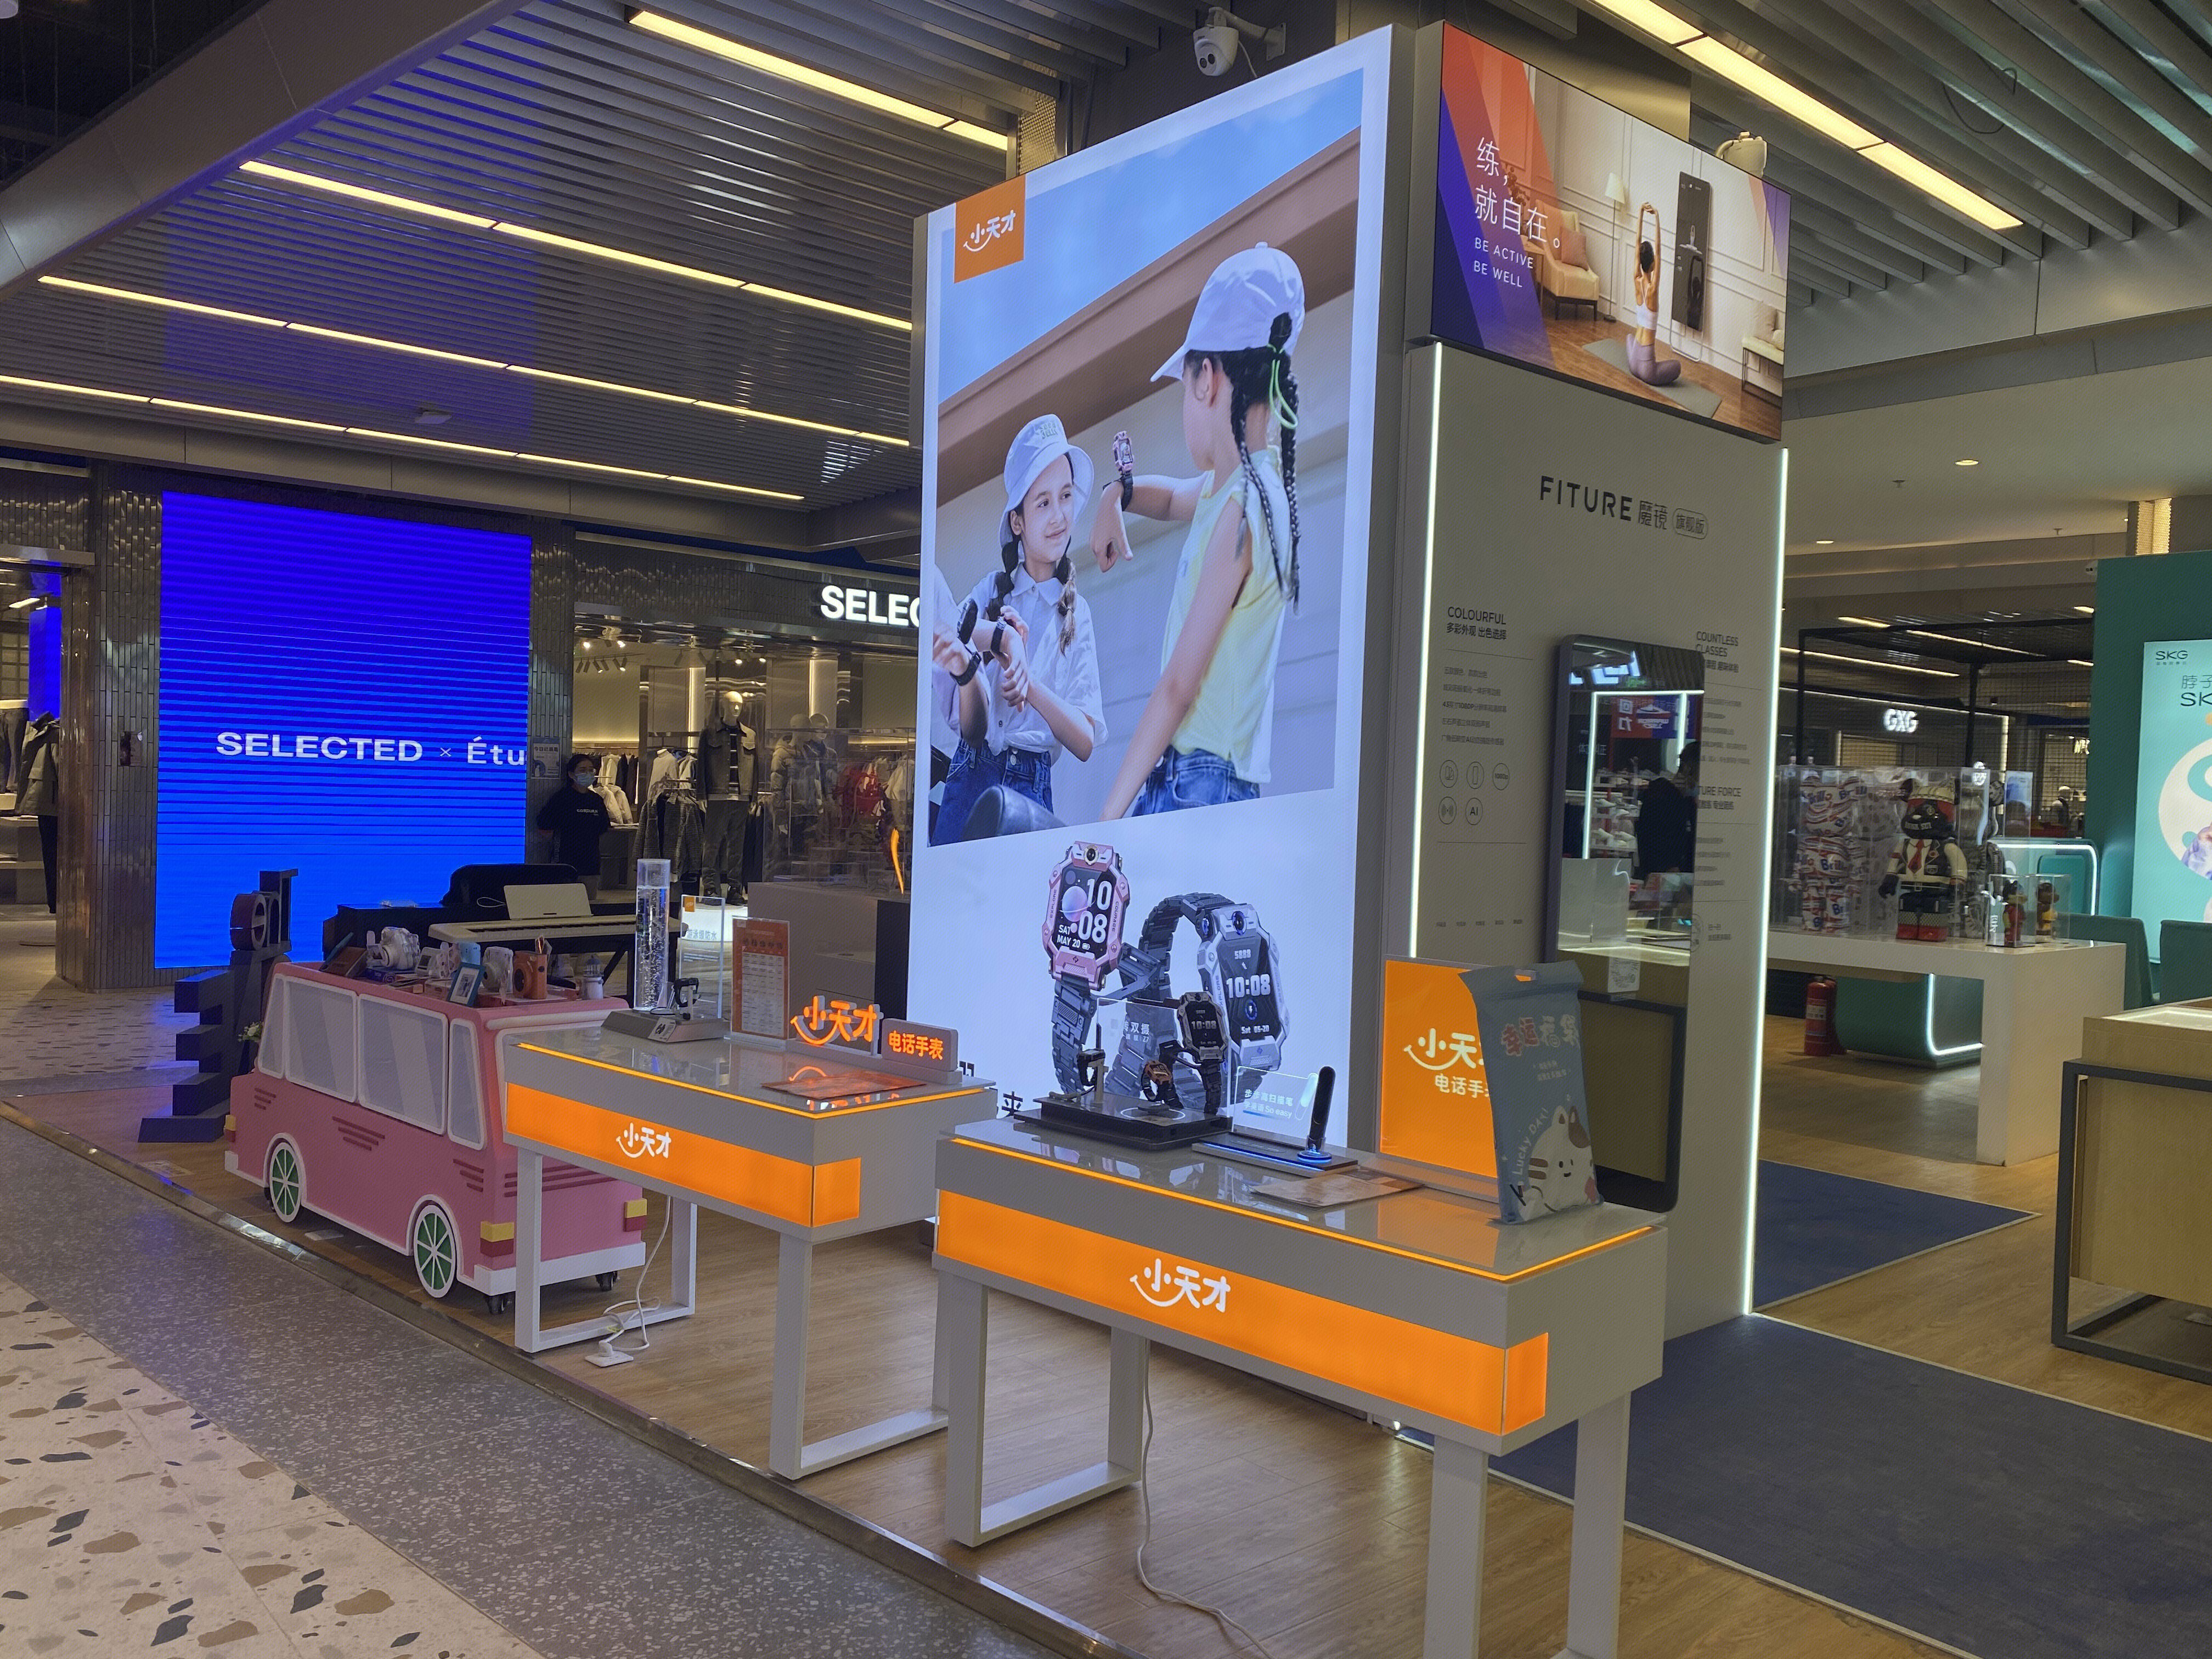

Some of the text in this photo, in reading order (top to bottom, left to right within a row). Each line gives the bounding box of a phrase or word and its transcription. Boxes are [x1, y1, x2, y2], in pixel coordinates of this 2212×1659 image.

[1475, 184, 1560, 249] 就自在。
[963, 210, 1016, 252] 小天才
[1475, 237, 1534, 269] BE ACTIVE
[1474, 260, 1523, 288] BE WELL
[1540, 475, 1633, 522] FITURE
[1638, 500, 1668, 530] 魔镜
[1448, 606, 1506, 625] COLOURFUL
[1696, 631, 1739, 646] COUNTLESS
[1696, 644, 1728, 657] CLASSES
[2155, 650, 2188, 661] SKG
[1884, 708, 1918, 733] GXG
[216, 732, 423, 762] SELECTED
[467, 736, 527, 766] Étu
[1718, 787, 1741, 798] FORCE
[1470, 806, 1479, 816] AI
[1087, 878, 1112, 910] 10
[1058, 924, 1071, 935] SAT
[1078, 911, 1108, 943] 08
[1111, 901, 1120, 933] COURAGE
[1057, 934, 1081, 948] MAY 20
[1226, 974, 1271, 998] 10:08
[790, 995, 878, 1045] 小天才
[1192, 1020, 1217, 1030] 10:08
[1254, 1025, 1269, 1034] 05-20
[888, 1030, 944, 1061] 电话手表
[1403, 1028, 1484, 1071] 小天
[1244, 1089, 1294, 1107] 步步高扫描笔
[1266, 1105, 1274, 1114] So
[1275, 1108, 1293, 1119] easy
[616, 1122, 672, 1159] 小天才
[1130, 1258, 1231, 1313] 小天才
